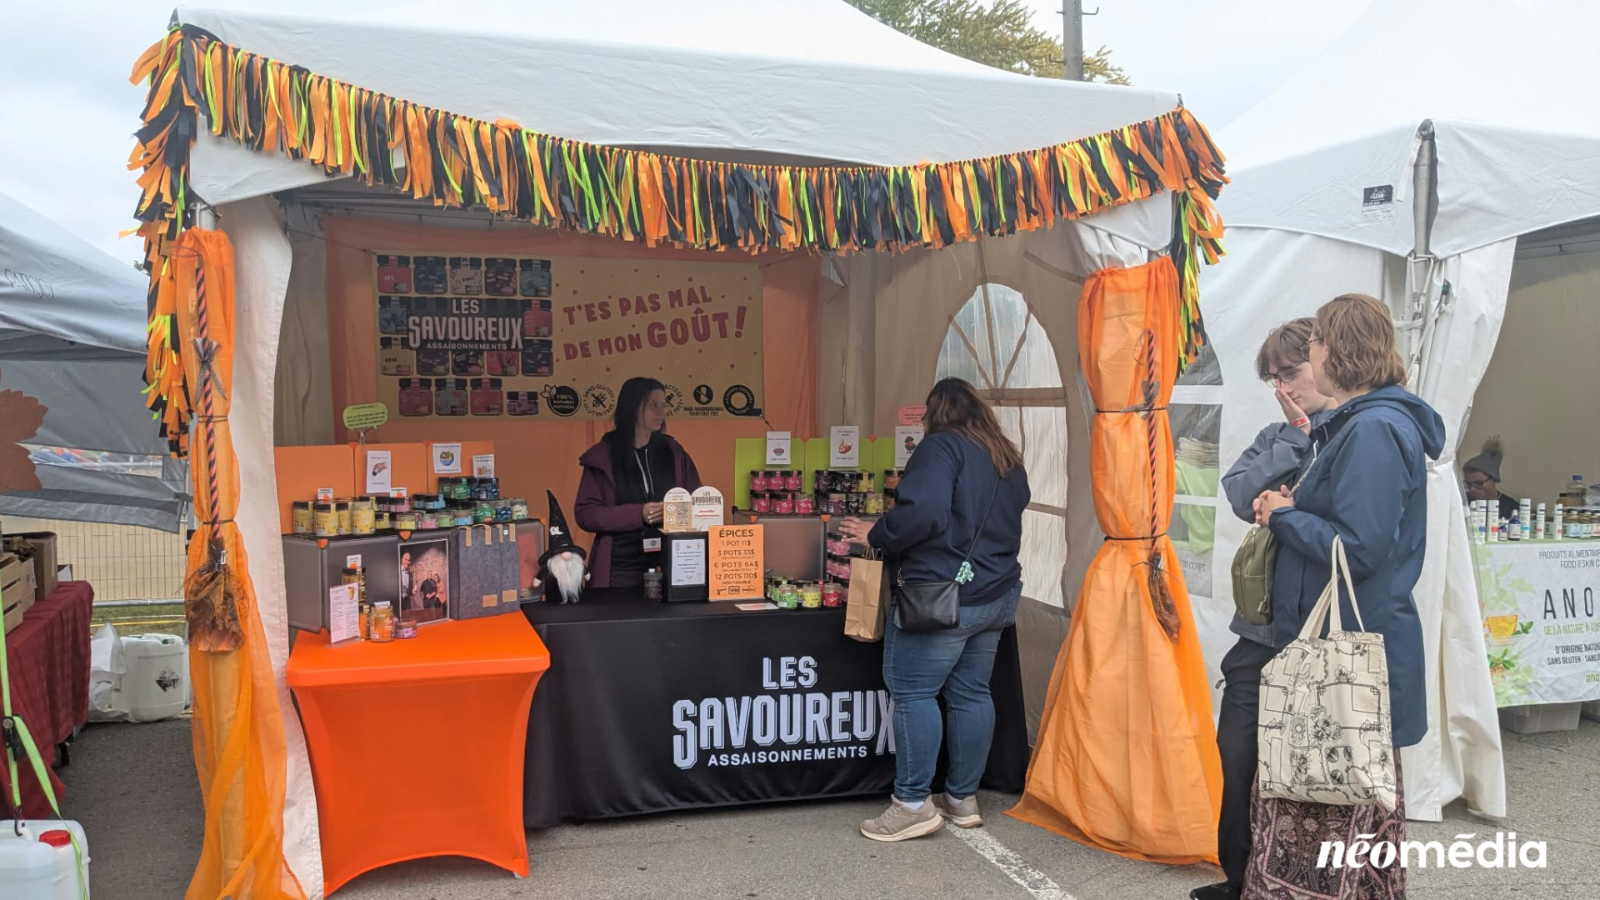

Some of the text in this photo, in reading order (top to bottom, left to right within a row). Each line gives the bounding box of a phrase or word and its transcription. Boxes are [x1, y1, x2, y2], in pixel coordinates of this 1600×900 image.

[452, 299, 480, 314] LES
[562, 286, 712, 326] T'ES PAS MAL
[408, 316, 524, 350] SAVOUREUX
[563, 306, 748, 361] DE MON GOÛT!
[596, 384, 615, 398] GLUTEN
[584, 403, 604, 417] GLUTEN
[719, 528, 754, 538] ÉPICES
[1538, 551, 1567, 559] PRODUITS
[1560, 561, 1576, 569] FOOD
[1544, 586, 1594, 620] ANO
[1544, 626, 1552, 635] DE
[1554, 625, 1561, 634] LA
[1563, 624, 1584, 634] NATURE
[1555, 644, 1583, 654] D'ORIGINE
[1547, 657, 1561, 666] SANS
[1562, 656, 1581, 664] GLUTEN
[762, 656, 818, 689] LES
[672, 690, 896, 770] SAVOUREUX
[708, 746, 868, 767] ASSAISONNEMENTS
